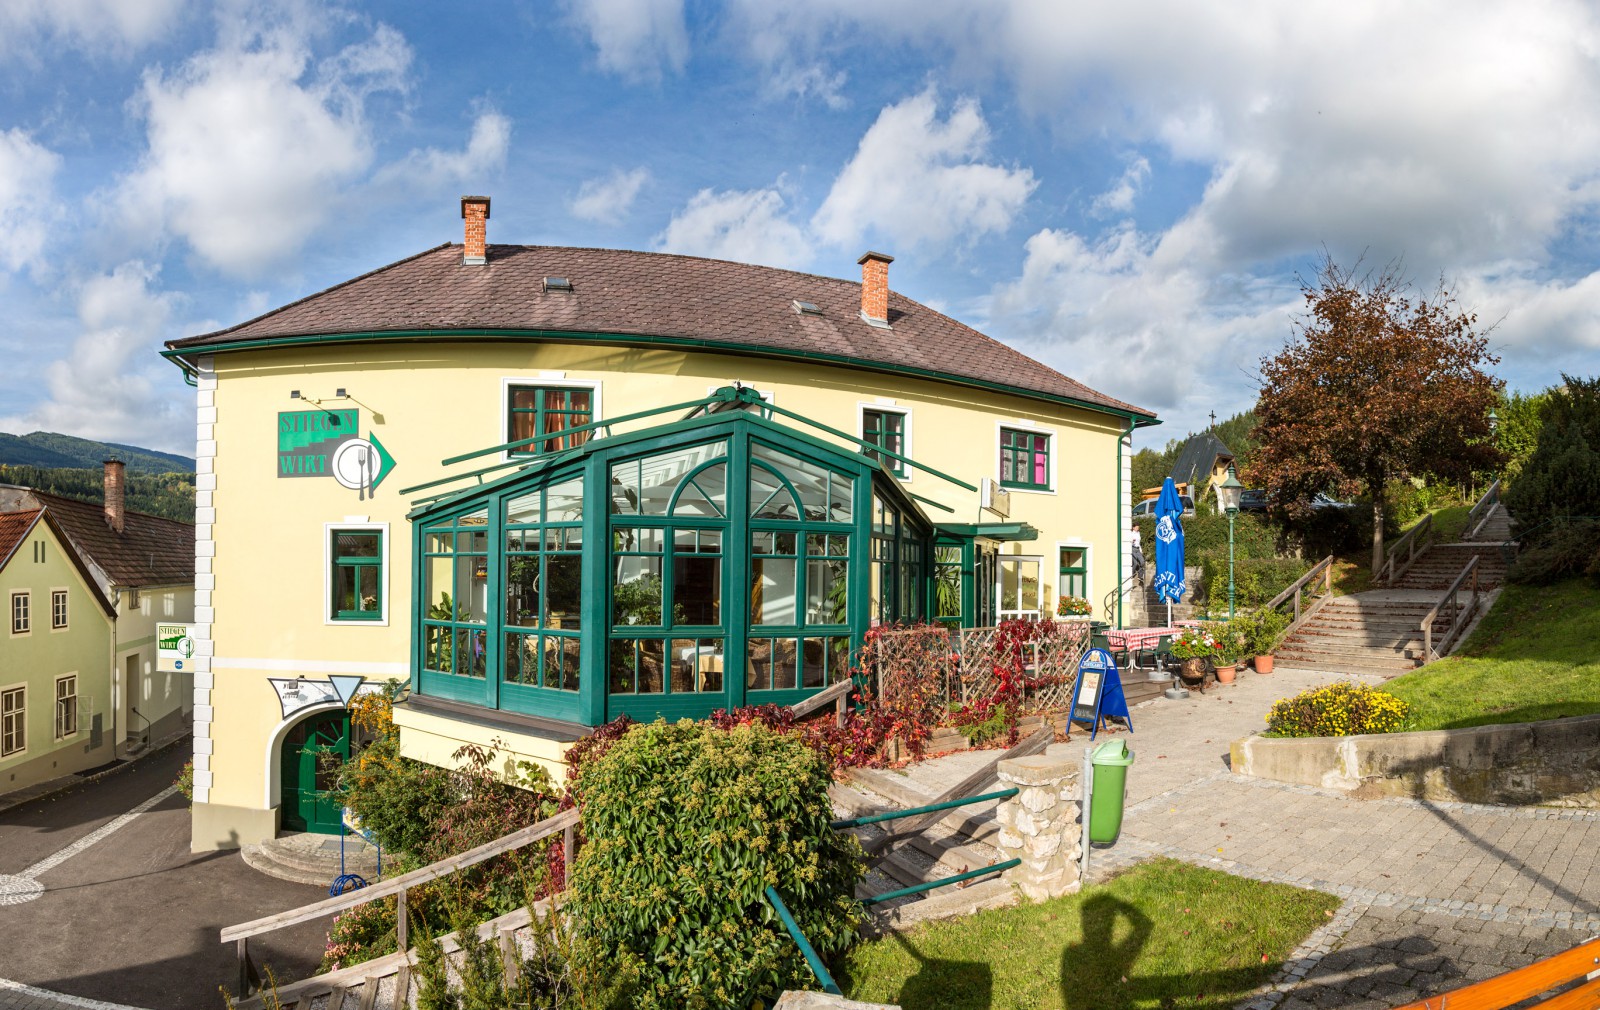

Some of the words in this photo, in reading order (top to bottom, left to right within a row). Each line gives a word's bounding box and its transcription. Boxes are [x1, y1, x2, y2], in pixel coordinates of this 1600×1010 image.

[281, 413, 353, 433] STIEGEN
[280, 455, 327, 474] WIRT
[160, 641, 176, 649] WIRT
